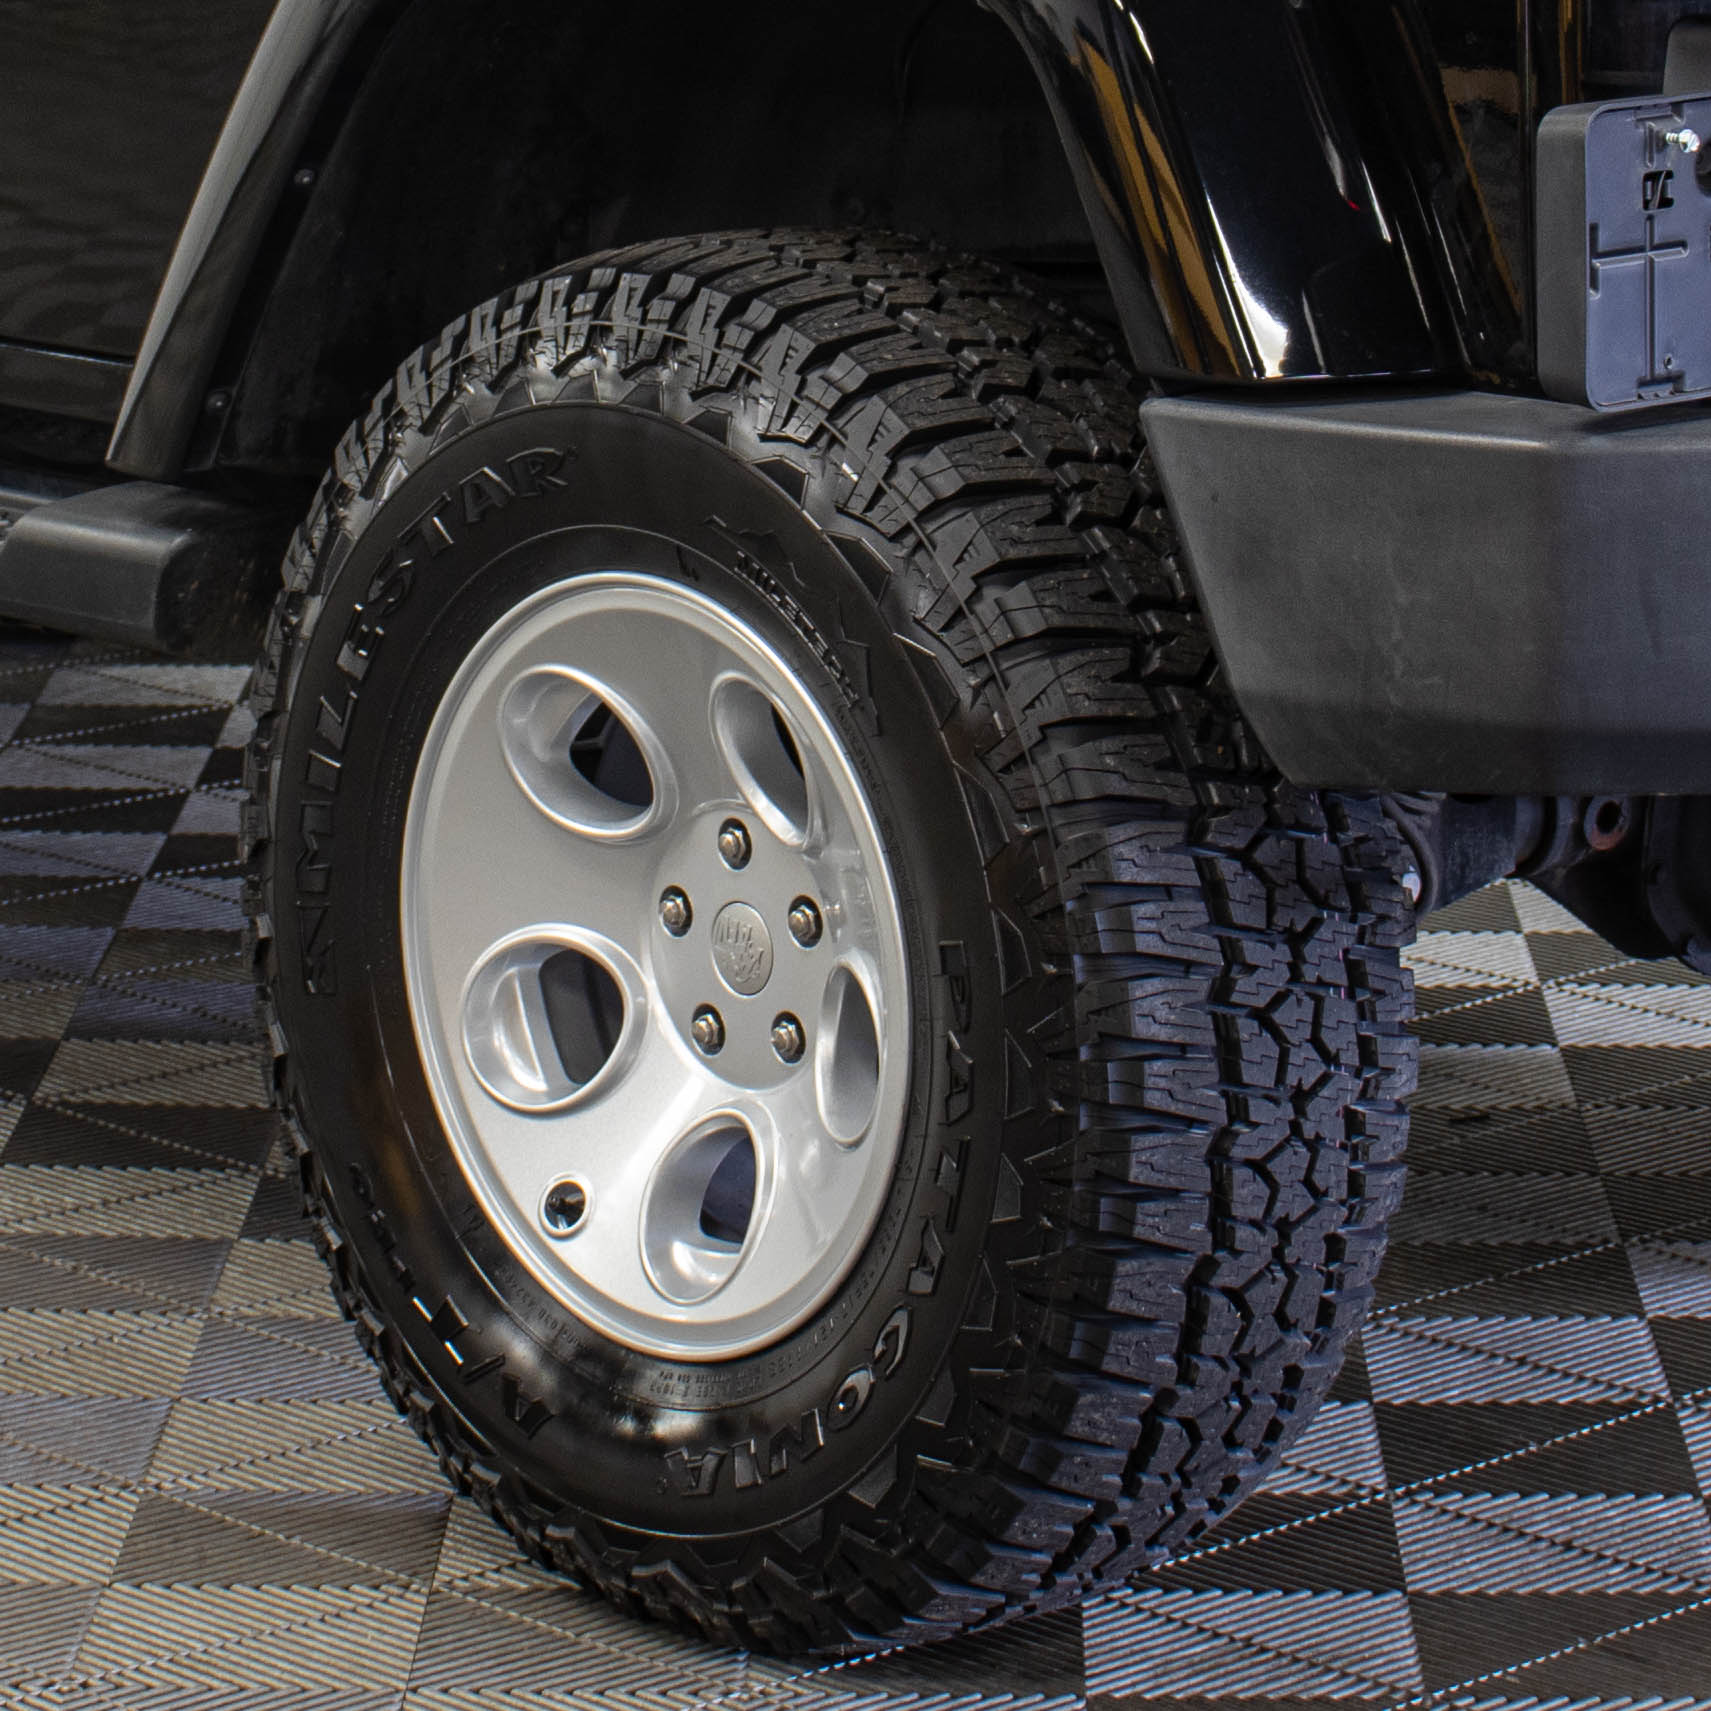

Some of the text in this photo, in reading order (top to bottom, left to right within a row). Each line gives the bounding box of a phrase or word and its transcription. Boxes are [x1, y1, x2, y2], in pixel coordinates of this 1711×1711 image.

[295, 446, 569, 894] MILESTAR
[412, 1291, 560, 1440] A/T
[663, 938, 976, 1499] PATAGONIA
